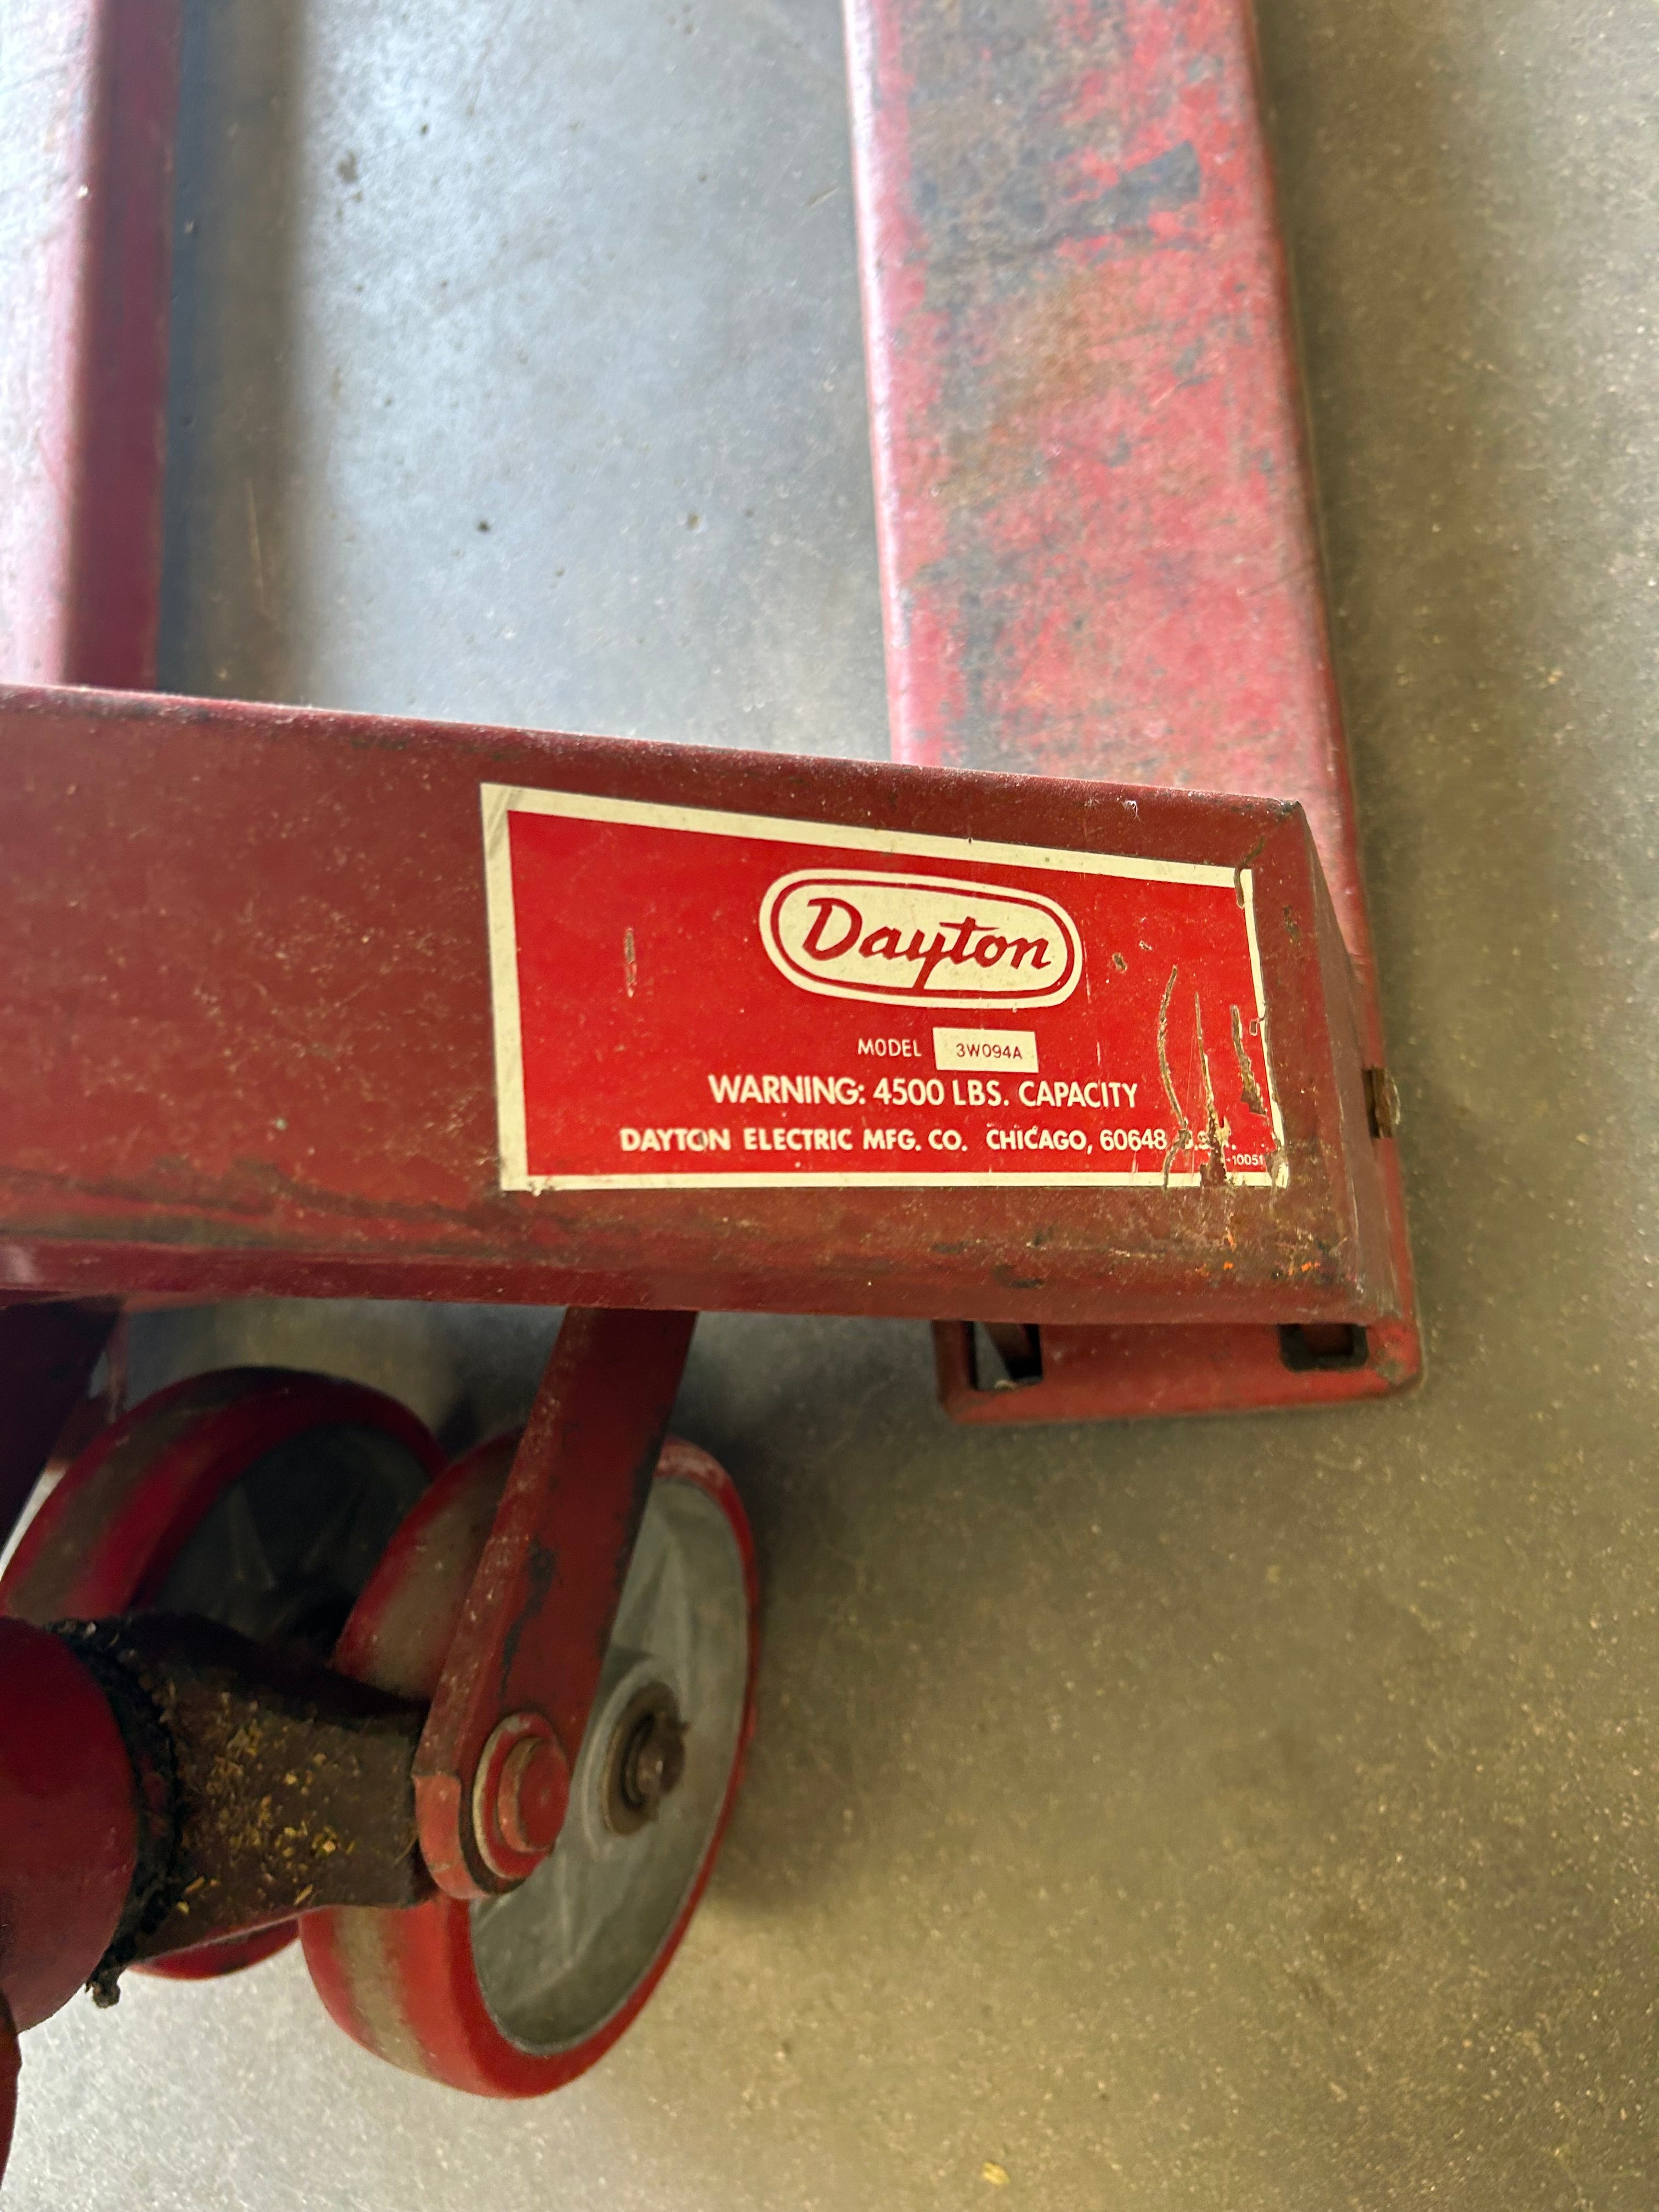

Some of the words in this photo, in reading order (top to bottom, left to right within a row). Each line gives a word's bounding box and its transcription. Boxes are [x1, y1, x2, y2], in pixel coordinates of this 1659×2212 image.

[802, 897, 1051, 989] Dayton
[857, 1038, 922, 1058] MODEL
[956, 1042, 1023, 1060] 3W094A
[708, 1075, 866, 1105] WARNING:
[873, 1079, 945, 1106] 4500
[952, 1080, 1009, 1107] LBS.
[1018, 1082, 1138, 1108] CAPACITY
[620, 1128, 730, 1152] DAYTON
[743, 1128, 853, 1151] ELECTRIC
[863, 1128, 921, 1151] MFG.
[928, 1130, 968, 1152] CO.
[986, 1128, 1093, 1154] CHICAGO,
[1099, 1128, 1167, 1150] 60648
